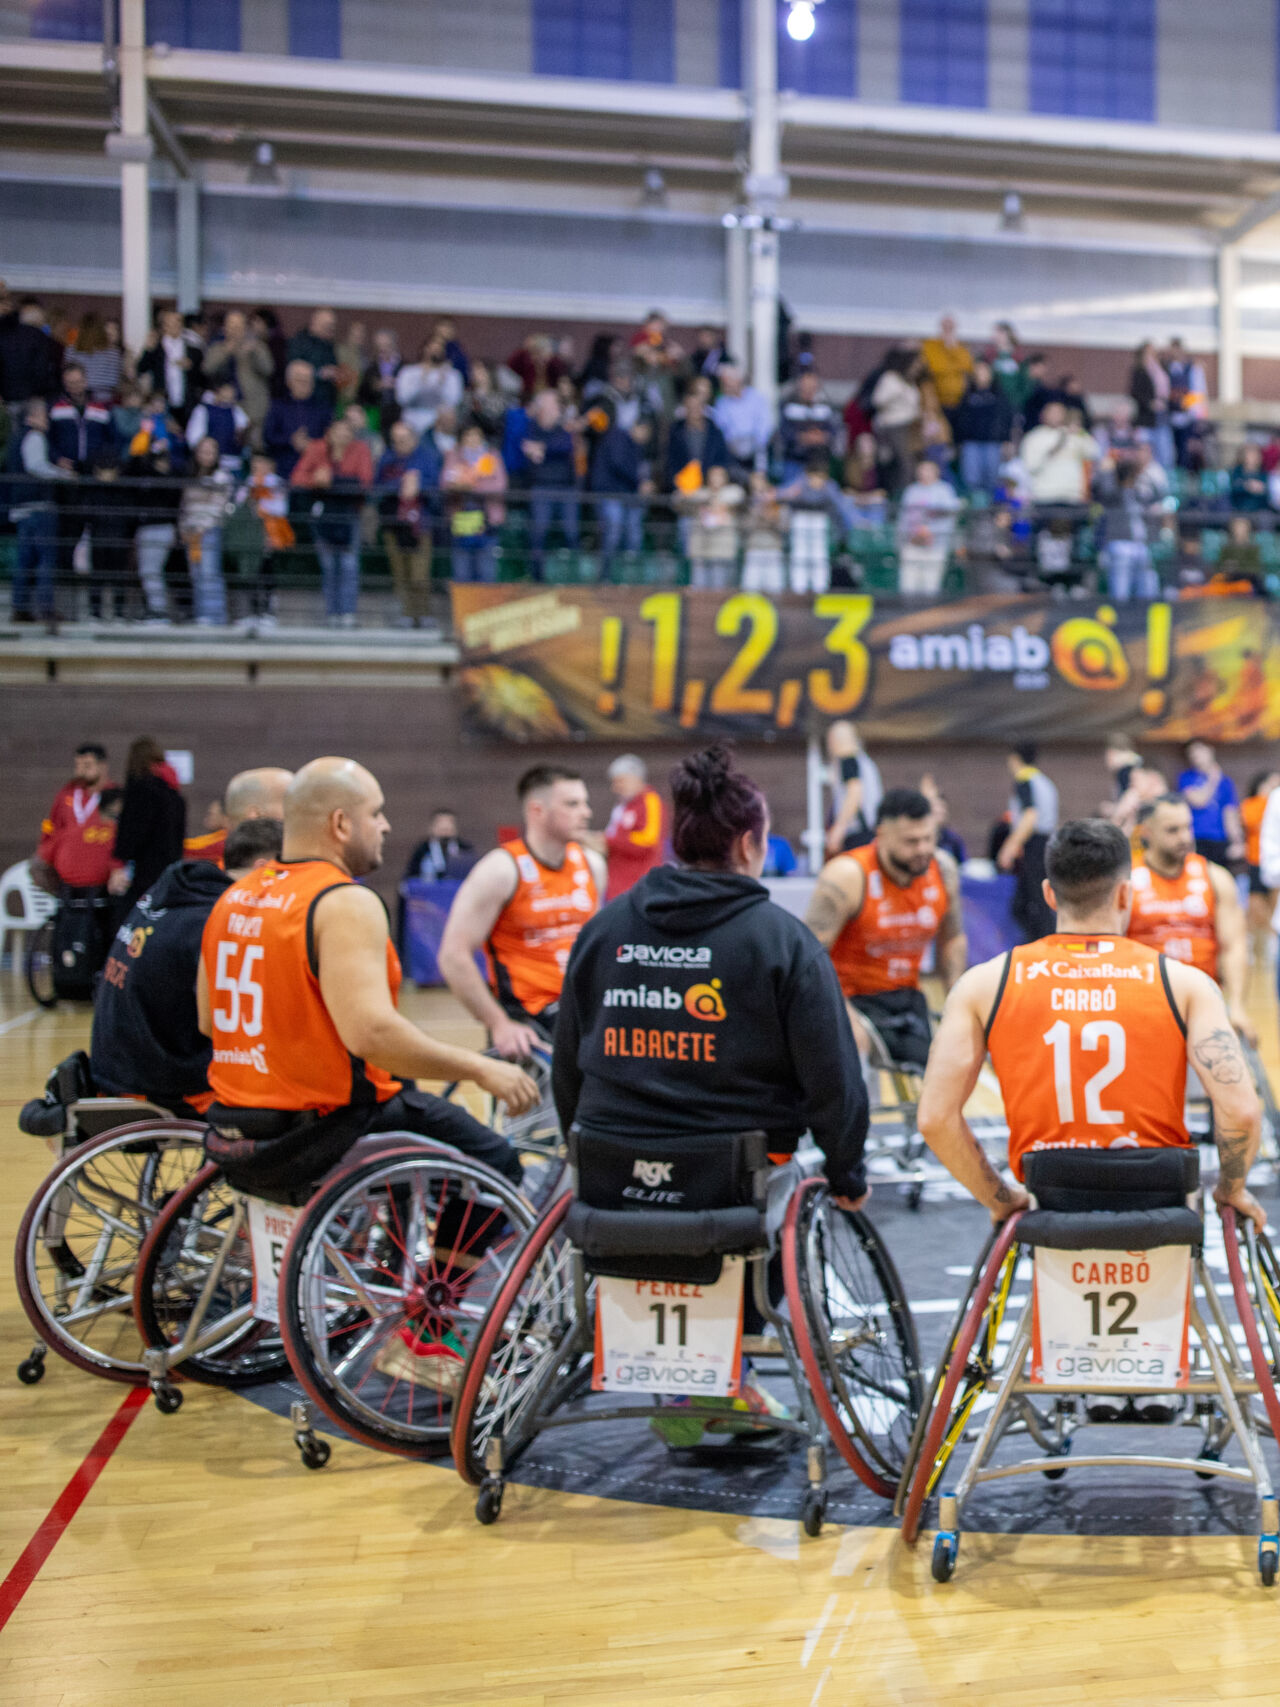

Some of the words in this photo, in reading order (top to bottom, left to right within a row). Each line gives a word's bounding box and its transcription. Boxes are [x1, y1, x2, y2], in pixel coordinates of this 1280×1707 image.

[888, 622, 1051, 671] amiab
[616, 944, 711, 963] gaviota
[1052, 962, 1143, 980] CaixaBank
[213, 940, 265, 1037] 55
[1051, 985, 1116, 1011] CARBÓ
[604, 1027, 717, 1062] ALBACETE
[1043, 1020, 1126, 1124] 12
[622, 1186, 686, 1204] ELITE
[1072, 1256, 1150, 1285] CARBÓ
[650, 1303, 687, 1346] 11
[1083, 1291, 1139, 1336] 12
[616, 1365, 717, 1385] gaviota
[1056, 1356, 1164, 1377] gaviota
